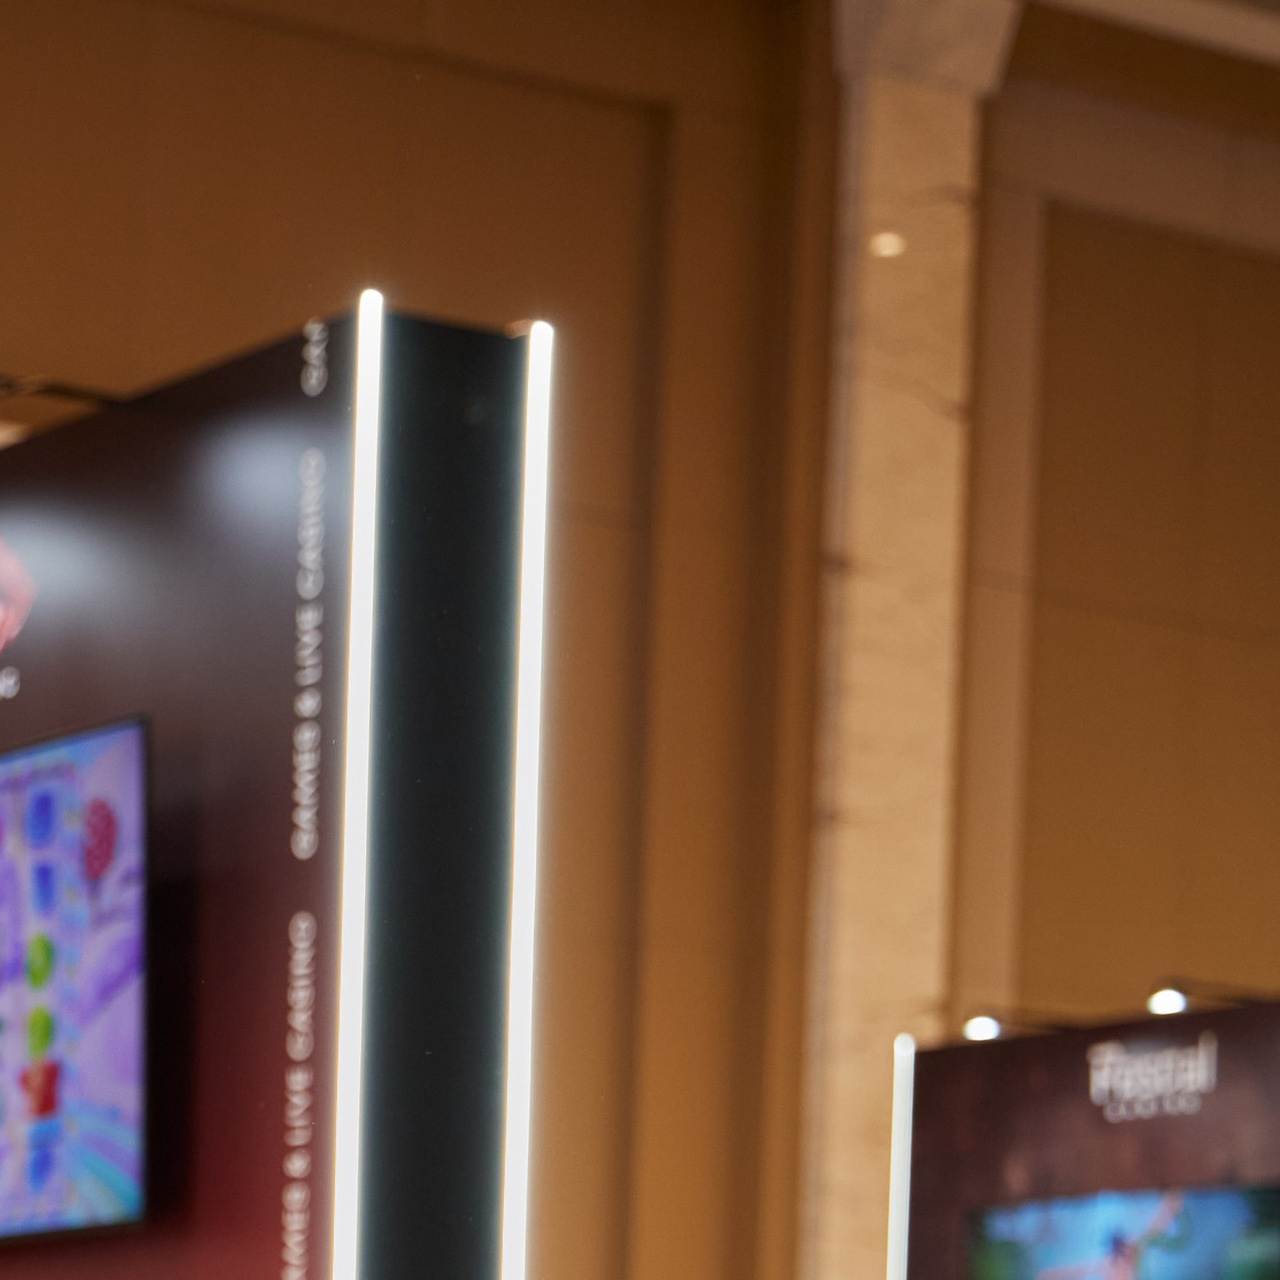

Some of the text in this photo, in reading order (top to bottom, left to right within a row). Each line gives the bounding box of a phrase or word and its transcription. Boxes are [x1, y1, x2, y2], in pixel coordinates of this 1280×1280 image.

[297, 447, 326, 600] CASINO
[295, 605, 322, 688] LIVE
[291, 720, 319, 860] GAMES
[286, 911, 317, 1061] CASINO
[285, 1064, 314, 1147] LIVE
